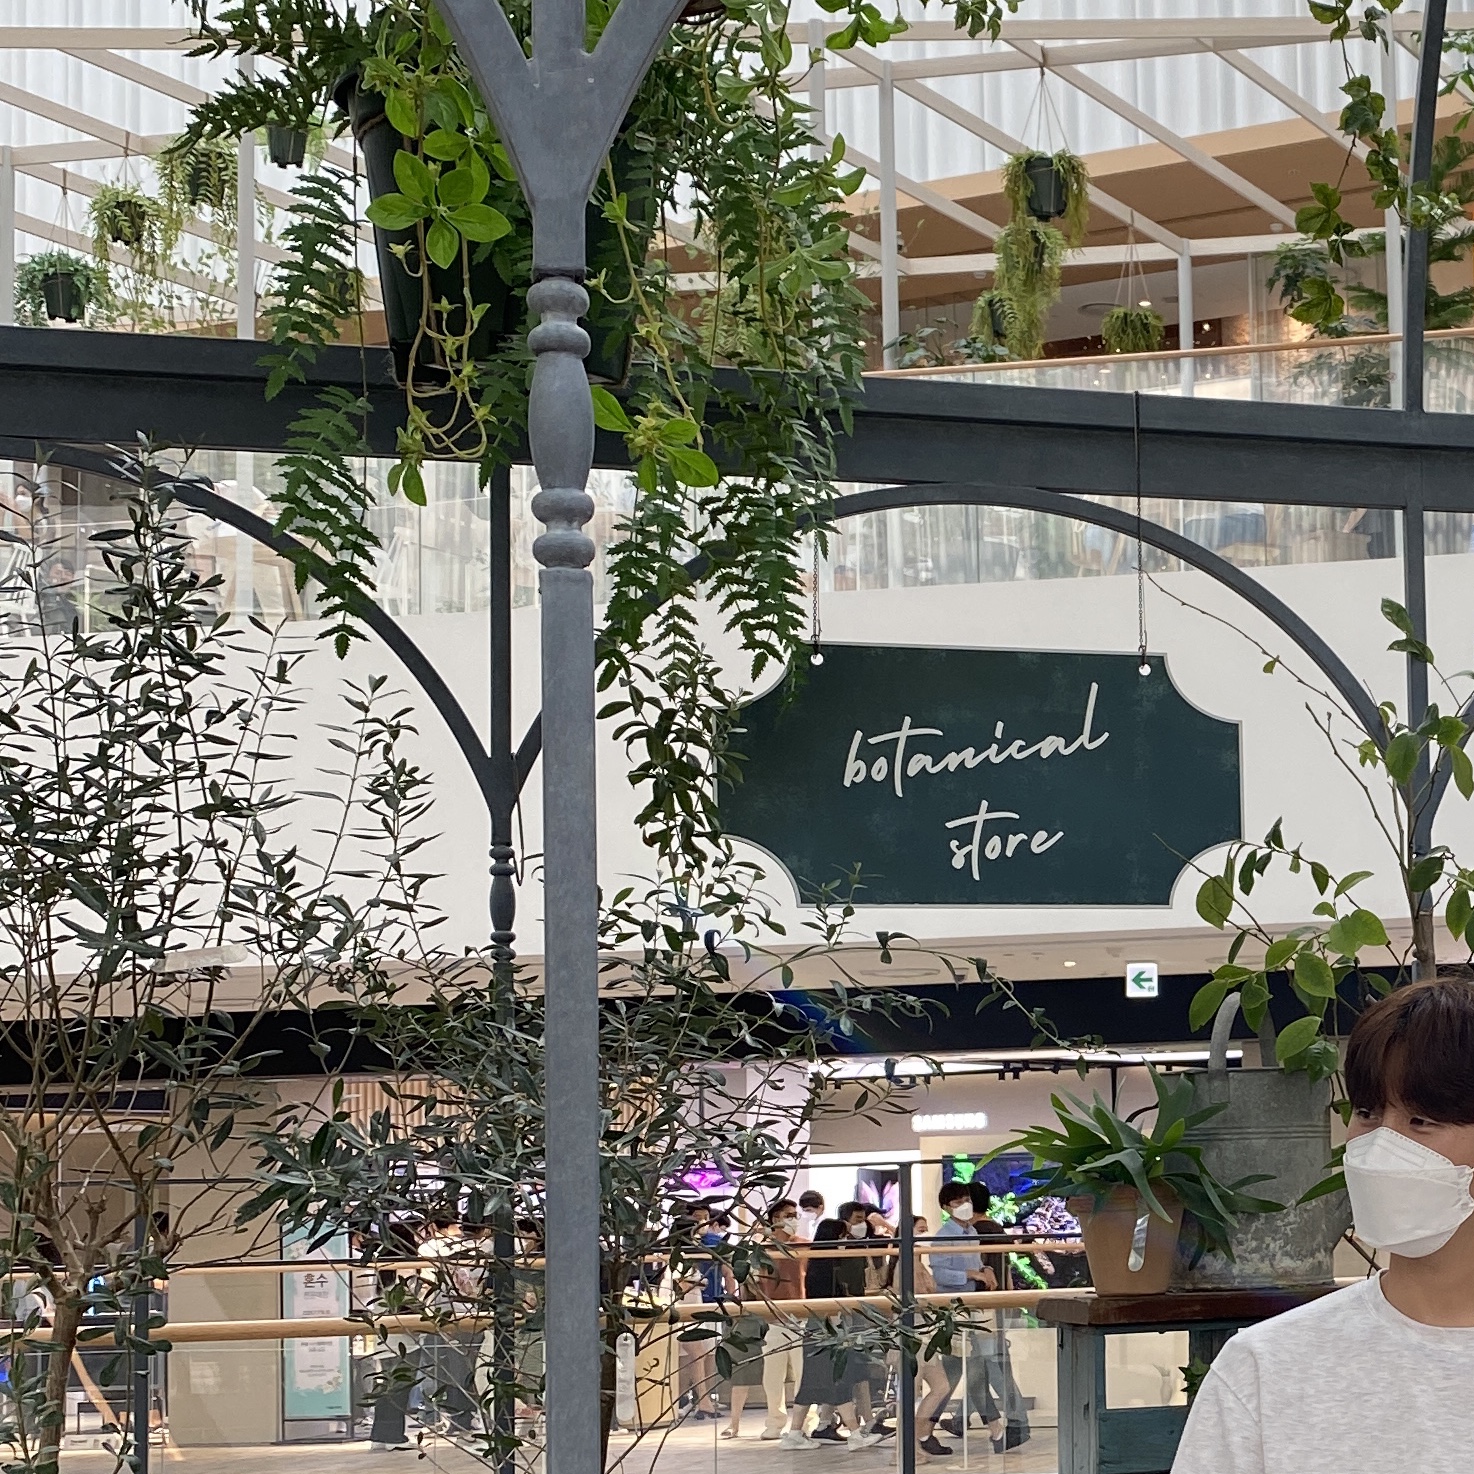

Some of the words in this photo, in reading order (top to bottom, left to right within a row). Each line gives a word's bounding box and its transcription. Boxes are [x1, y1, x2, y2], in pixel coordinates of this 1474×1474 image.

[842, 682, 1110, 798] botanical
[944, 799, 1065, 881] store
[303, 1273, 329, 1289] 혼수
